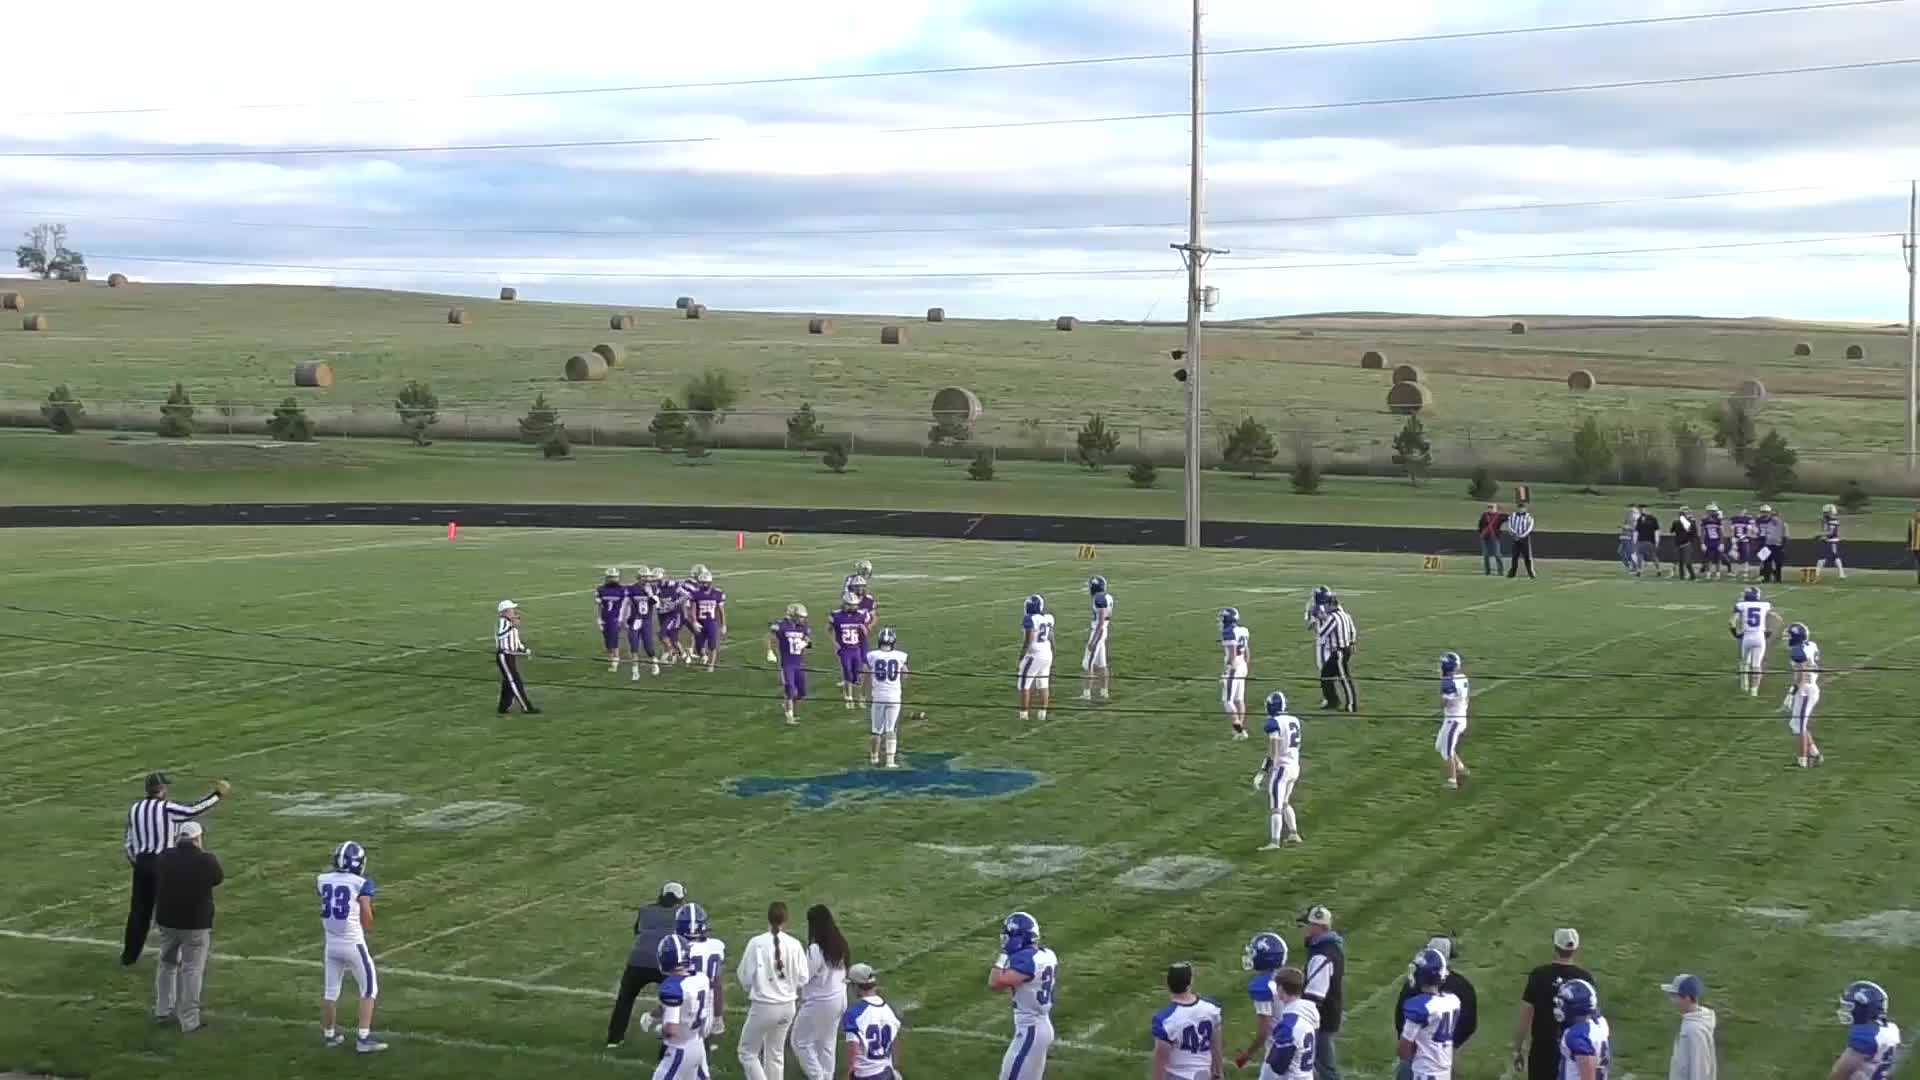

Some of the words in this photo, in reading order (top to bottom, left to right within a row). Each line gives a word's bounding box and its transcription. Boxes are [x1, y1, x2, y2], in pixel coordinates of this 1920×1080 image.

[1423, 557, 1438, 569] 20
[1747, 607, 1761, 627] 5
[841, 628, 860, 645] 26
[1288, 721, 1301, 748] 2
[320, 883, 351, 921] 33
